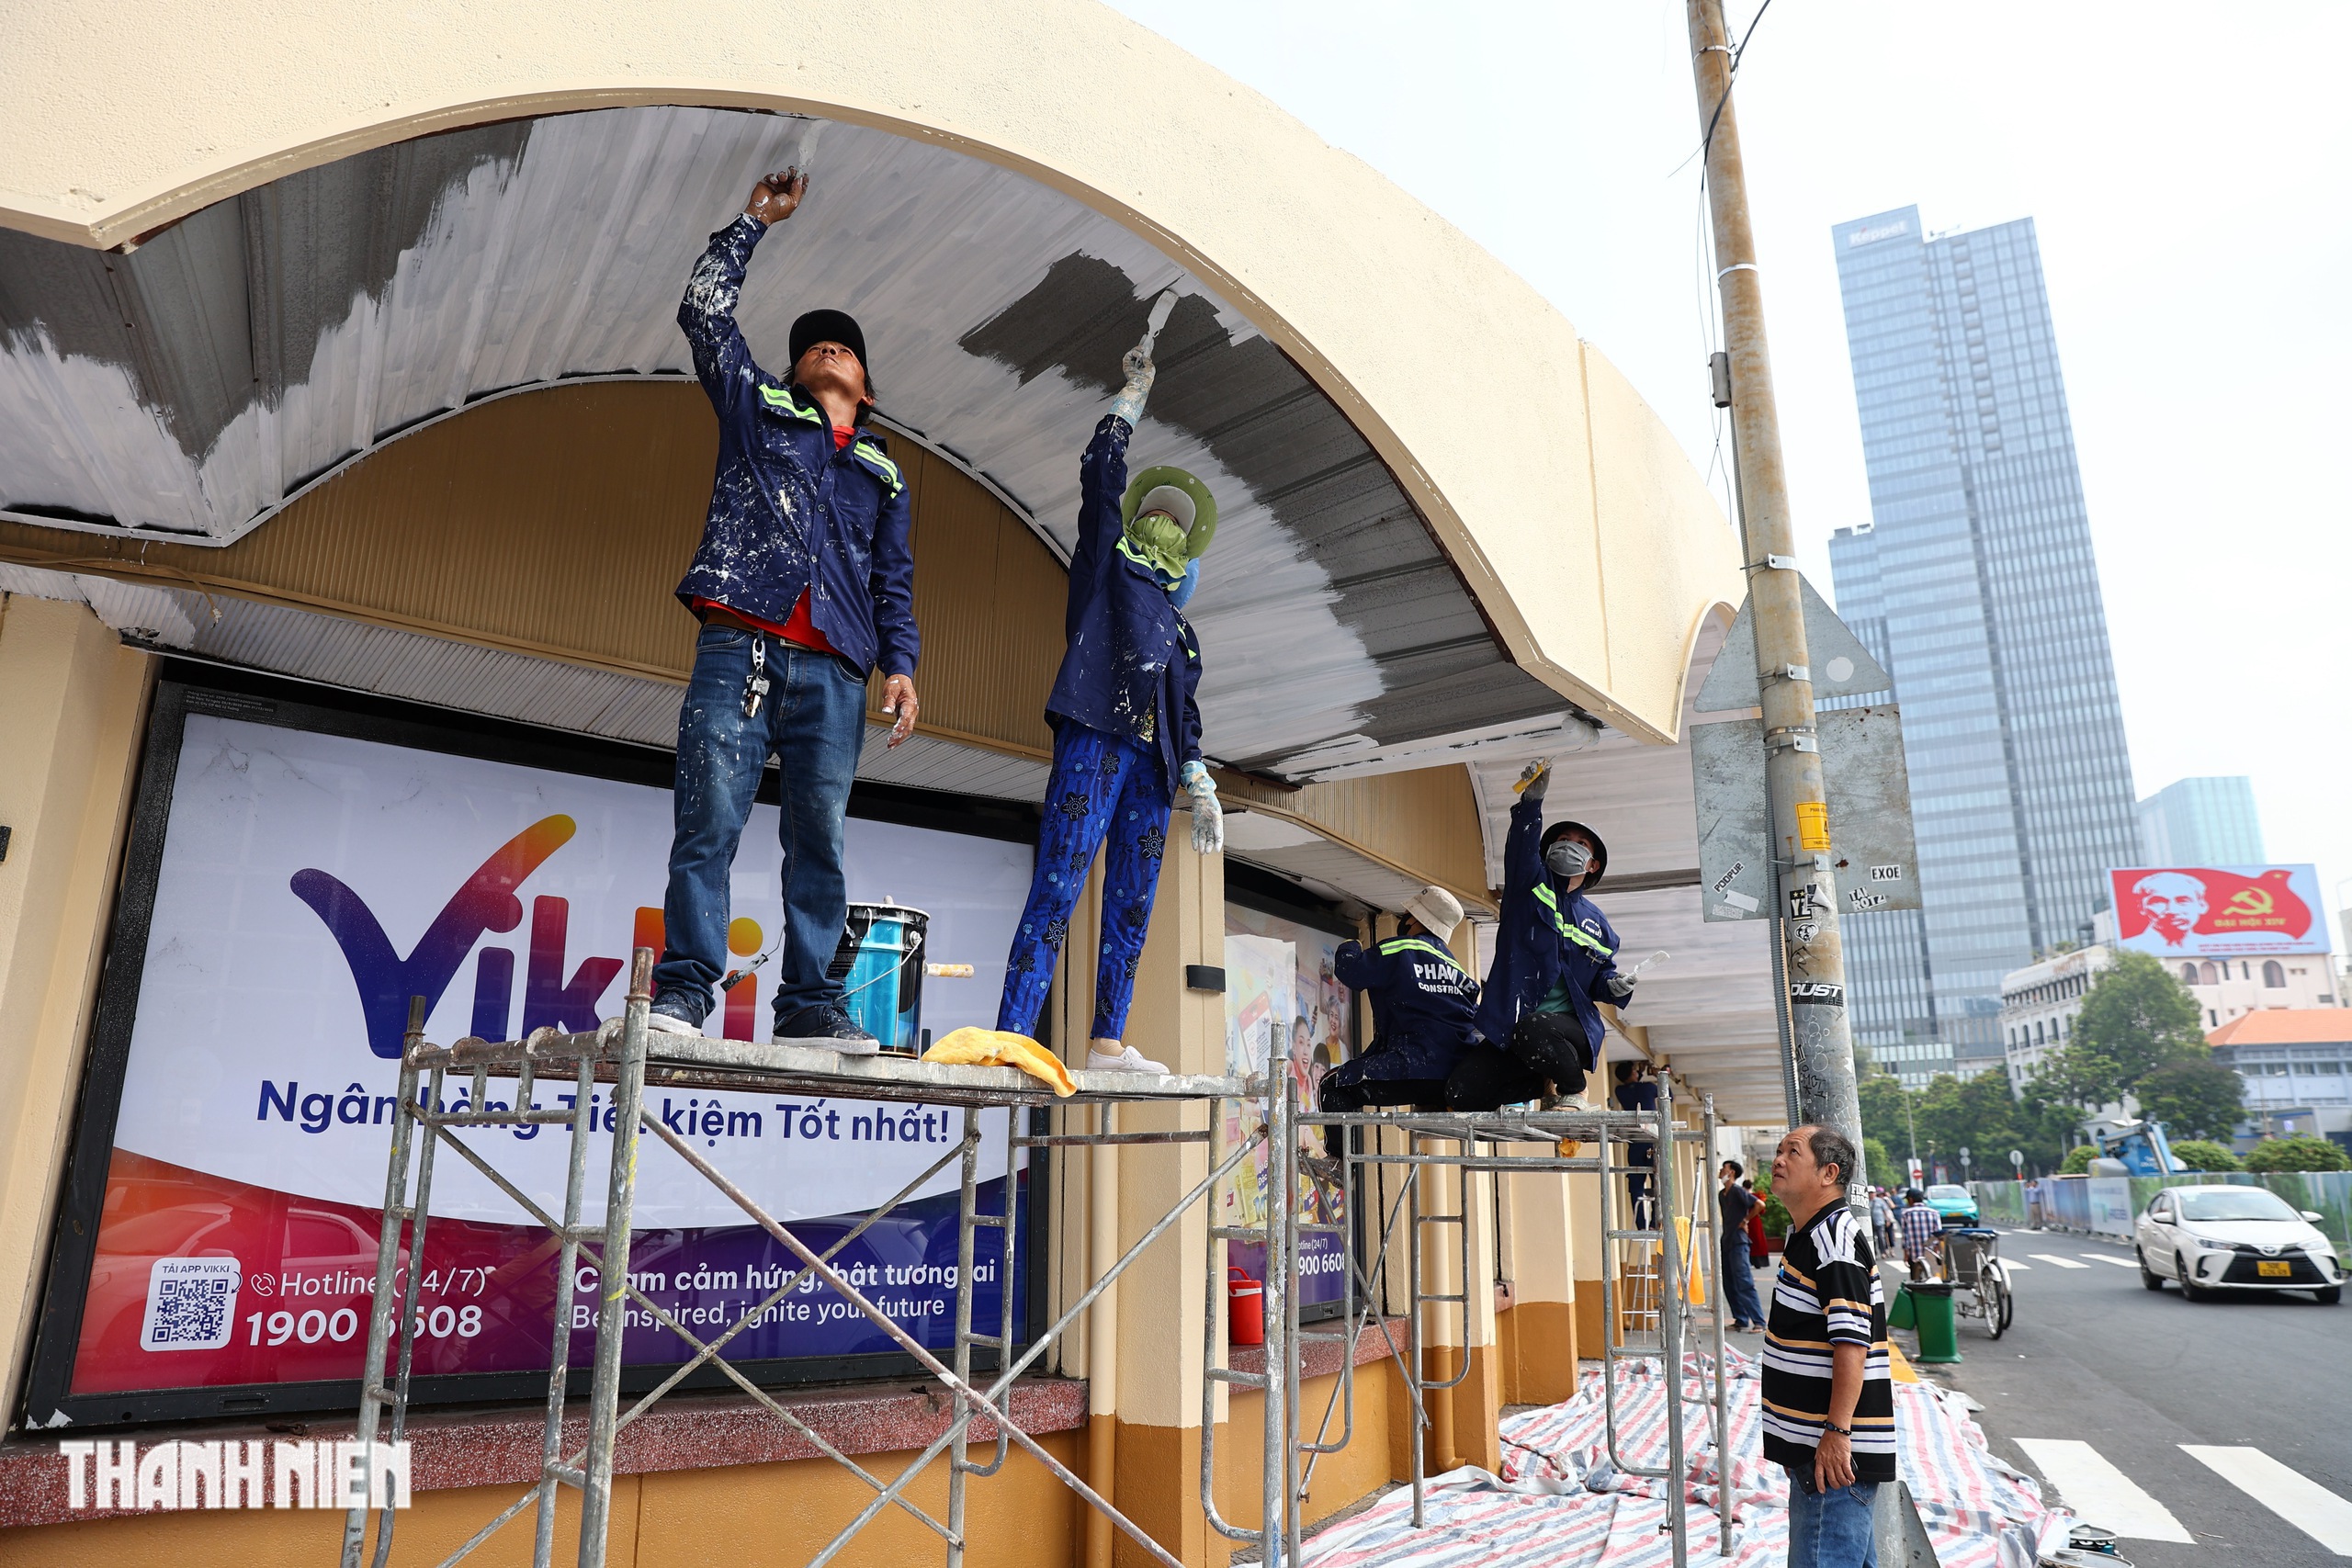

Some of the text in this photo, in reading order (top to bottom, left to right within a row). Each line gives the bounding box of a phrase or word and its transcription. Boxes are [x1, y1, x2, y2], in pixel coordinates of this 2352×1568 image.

[1791, 983, 1842, 998] DUST
[668, 1097, 763, 1147] kiệm
[775, 1099, 841, 1141] Tốt
[851, 1100, 949, 1144] nhất!
[1311, 1237, 1329, 1251] (24/7)
[162, 1262, 230, 1274] TẢI APP VIKKI
[674, 1262, 738, 1292] cảm
[745, 1262, 824, 1294] hứng,
[831, 1261, 878, 1294] bật
[885, 1263, 959, 1290] tương
[1298, 1255, 1320, 1276] 900
[280, 1270, 378, 1296] Hotline
[624, 1302, 732, 1332] nspired,
[740, 1299, 811, 1329] ignite
[876, 1295, 945, 1318] future
[245, 1308, 358, 1347] 1900
